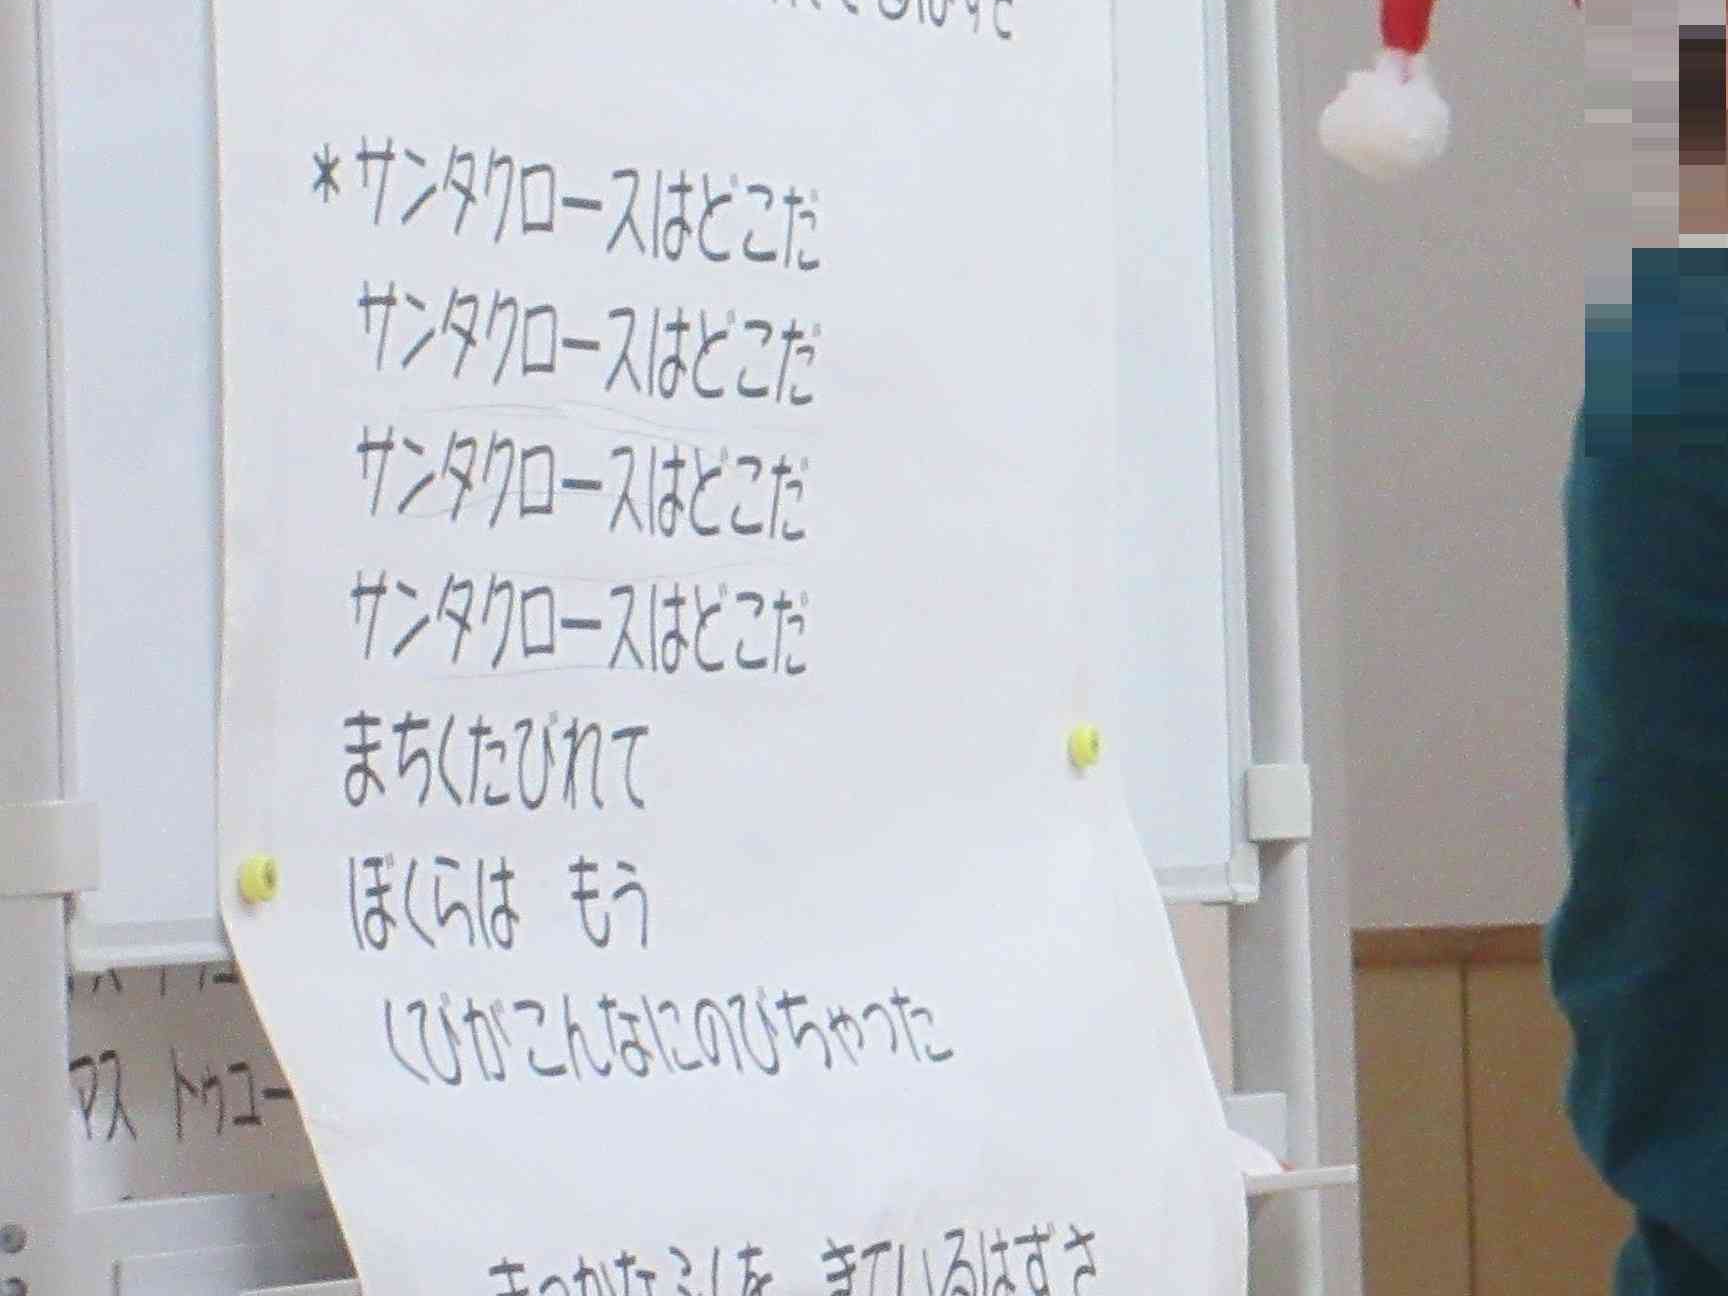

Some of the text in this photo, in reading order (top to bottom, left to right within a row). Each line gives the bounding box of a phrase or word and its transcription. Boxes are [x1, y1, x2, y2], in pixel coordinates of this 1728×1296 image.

[357, 279, 822, 407] サンタクロースはどこだ
[355, 425, 811, 542] サンタクロースはどこだ
[350, 569, 811, 676] サンタクロースはどこだ
[342, 708, 651, 810] まちくたびれて
[348, 854, 650, 952] ぼくらは もう
[383, 985, 955, 1087] くびがこんなにのびちゃった
